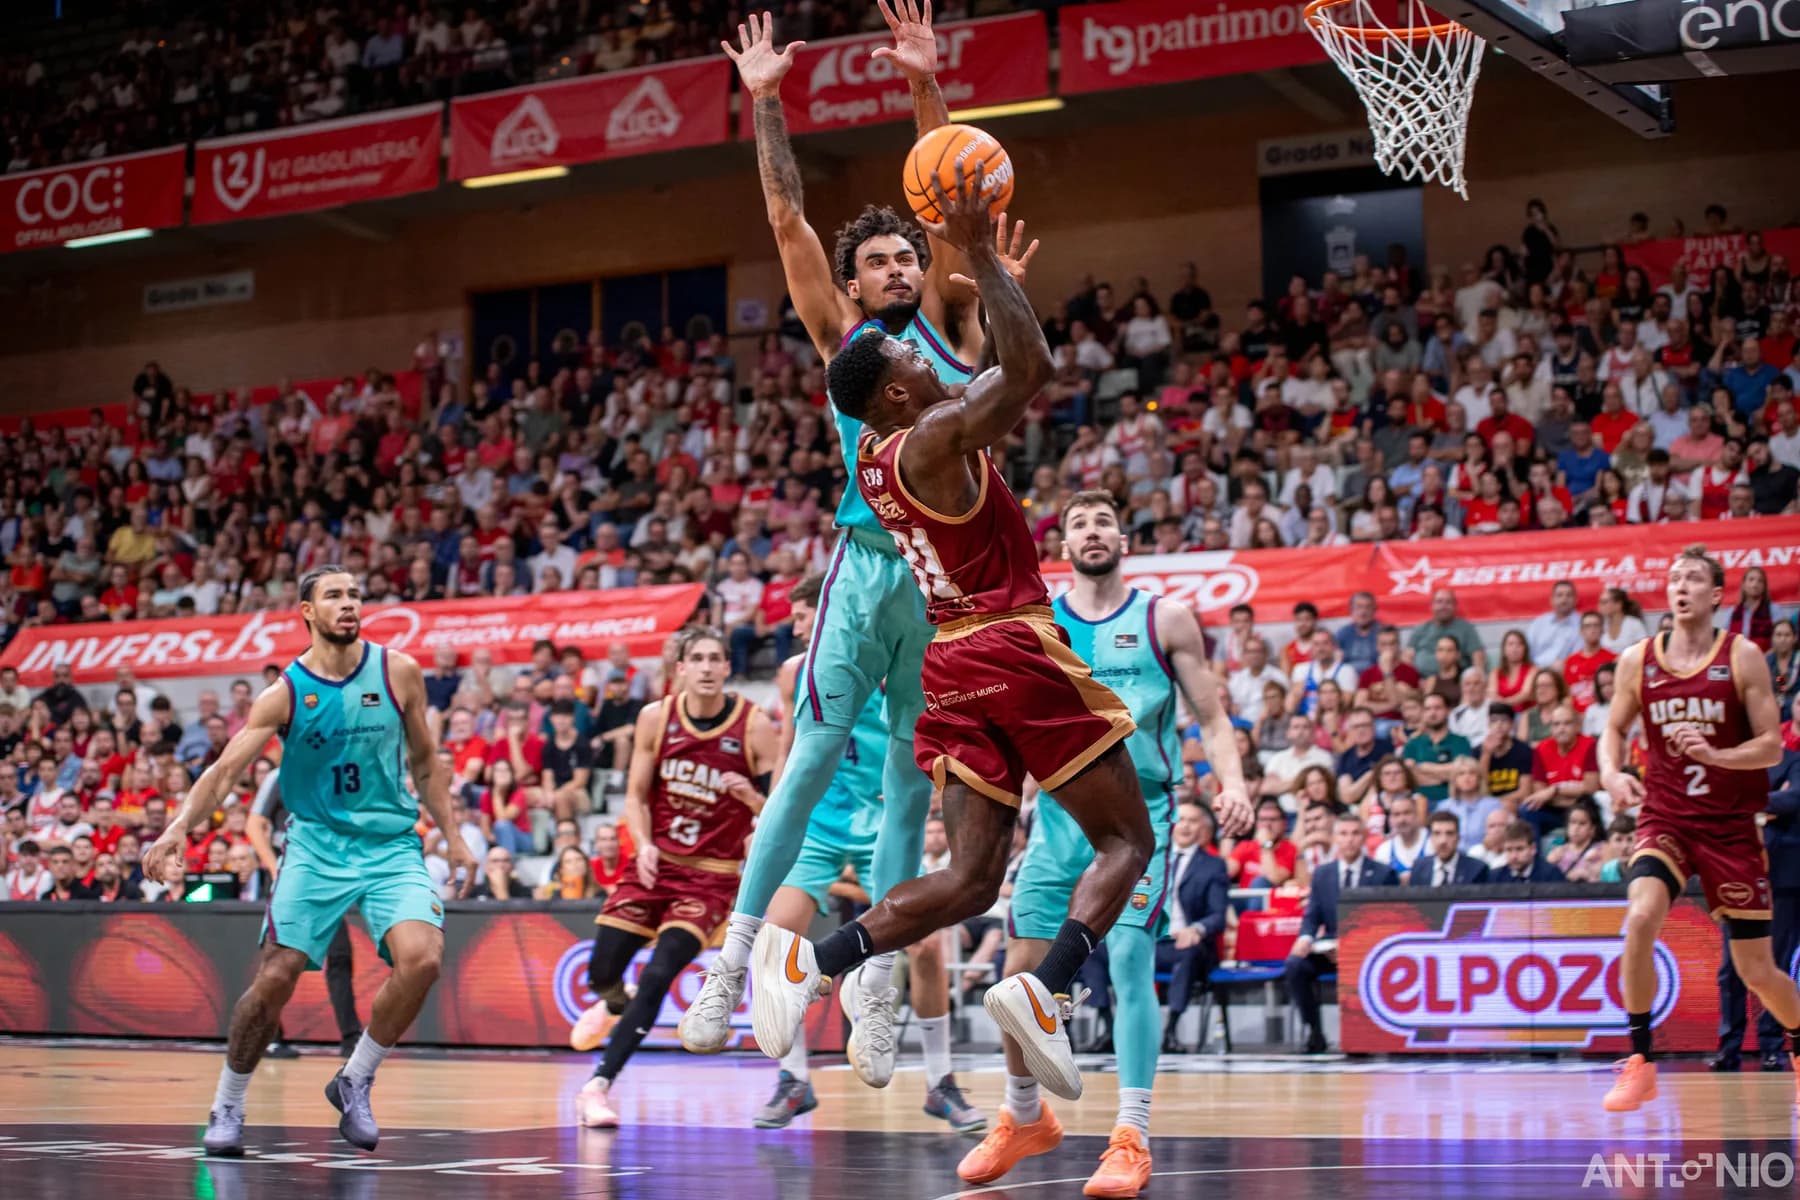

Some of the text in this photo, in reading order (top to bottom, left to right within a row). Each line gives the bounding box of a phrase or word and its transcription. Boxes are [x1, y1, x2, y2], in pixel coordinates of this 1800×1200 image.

[809, 97, 879, 124] Grupo
[1447, 554, 1638, 587] ESTRELLA
[977, 682, 1009, 697] MURCIA
[1649, 697, 1726, 724] UCAM
[331, 762, 361, 796] 13
[660, 758, 728, 794] UCAM
[1683, 764, 1711, 797] 2
